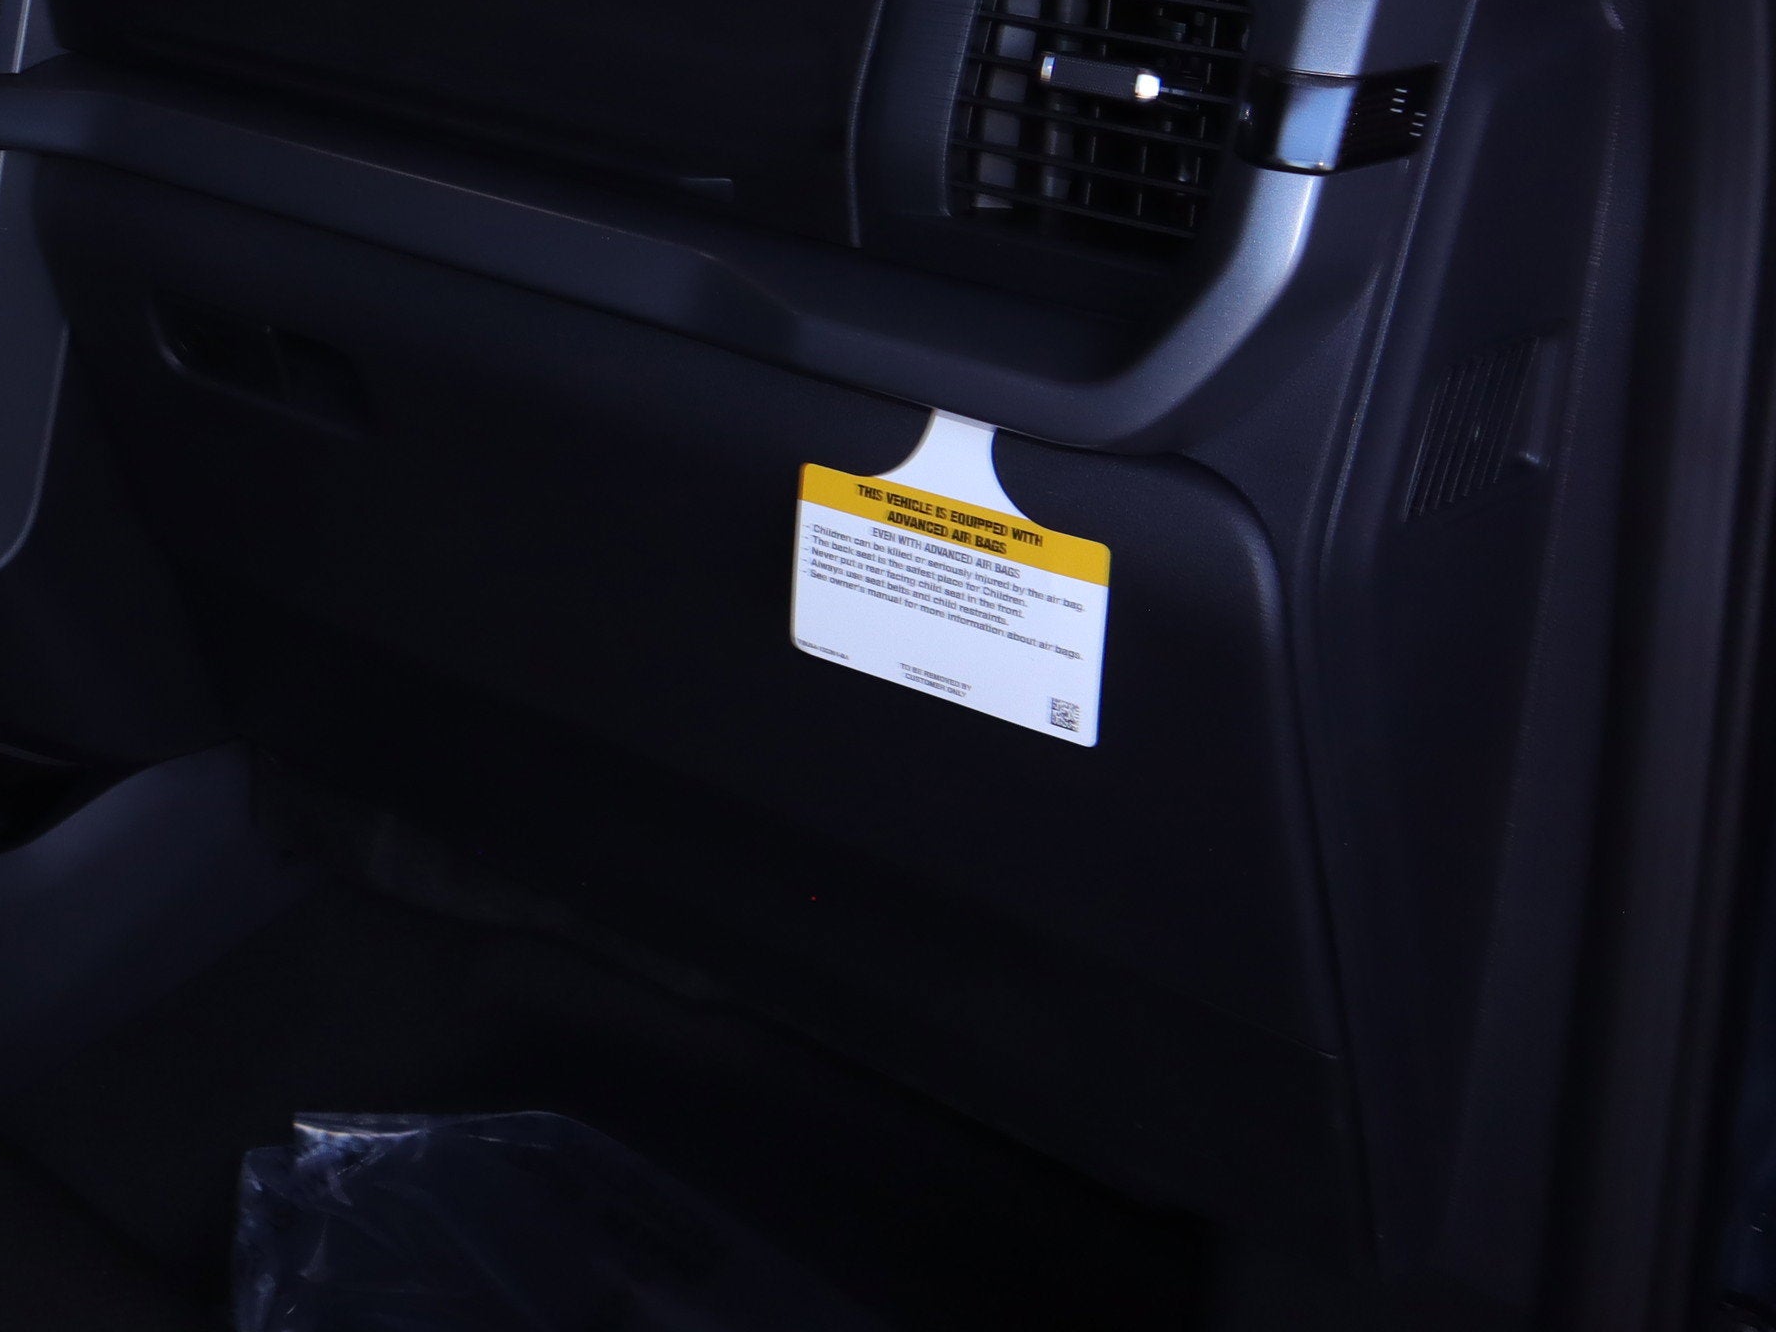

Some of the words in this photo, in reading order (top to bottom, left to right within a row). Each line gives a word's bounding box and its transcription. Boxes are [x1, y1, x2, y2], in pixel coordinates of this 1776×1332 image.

[858, 484, 884, 503] THIS
[887, 492, 933, 516] VEHICLE
[936, 506, 947, 521] IS
[950, 510, 1008, 537] EQUIPPED
[1011, 527, 1043, 548] WITH
[887, 509, 948, 538] ADVANCED
[951, 528, 972, 545] AIR
[975, 535, 1007, 555] BAGS
[811, 546, 838, 562] Never
[840, 557, 857, 568] put
[865, 564, 884, 576] rear
[886, 569, 915, 588] facing
[918, 580, 942, 594] child
[944, 589, 965, 600] seat
[967, 594, 976, 604] in
[979, 597, 995, 610] the
[811, 558, 843, 575] Always
[846, 571, 862, 581] use
[865, 576, 885, 588] seat
[887, 580, 910, 595] belts
[912, 591, 930, 602] and
[933, 596, 957, 610] child
[812, 535, 829, 548] The
[831, 541, 853, 555] back
[856, 550, 875, 562] seat
[877, 556, 886, 565] is
[888, 558, 903, 570] the
[905, 565, 935, 579] safest
[937, 574, 963, 588] place
[966, 582, 980, 593] for
[813, 523, 851, 543] Children
[854, 537, 870, 548] can
[873, 541, 885, 553] be
[887, 545, 912, 561] killed
[914, 555, 925, 565] or
[928, 559, 972, 581] seriously
[975, 573, 1010, 590] injured
[1012, 583, 1026, 597] by
[1028, 588, 1044, 600] the
[1046, 594, 1061, 605] air
[872, 527, 895, 543] EVEN
[898, 534, 921, 550] WITH
[924, 542, 972, 565] ADVANCED
[976, 557, 993, 571] AIR
[994, 562, 1020, 580] BAGS
[810, 569, 827, 582] See
[829, 577, 865, 593] owner's
[867, 588, 902, 605] manual
[904, 598, 918, 610] for
[920, 605, 945, 619] more
[948, 613, 1004, 637] information
[1007, 631, 1036, 647] about
[1038, 641, 1052, 652] air
